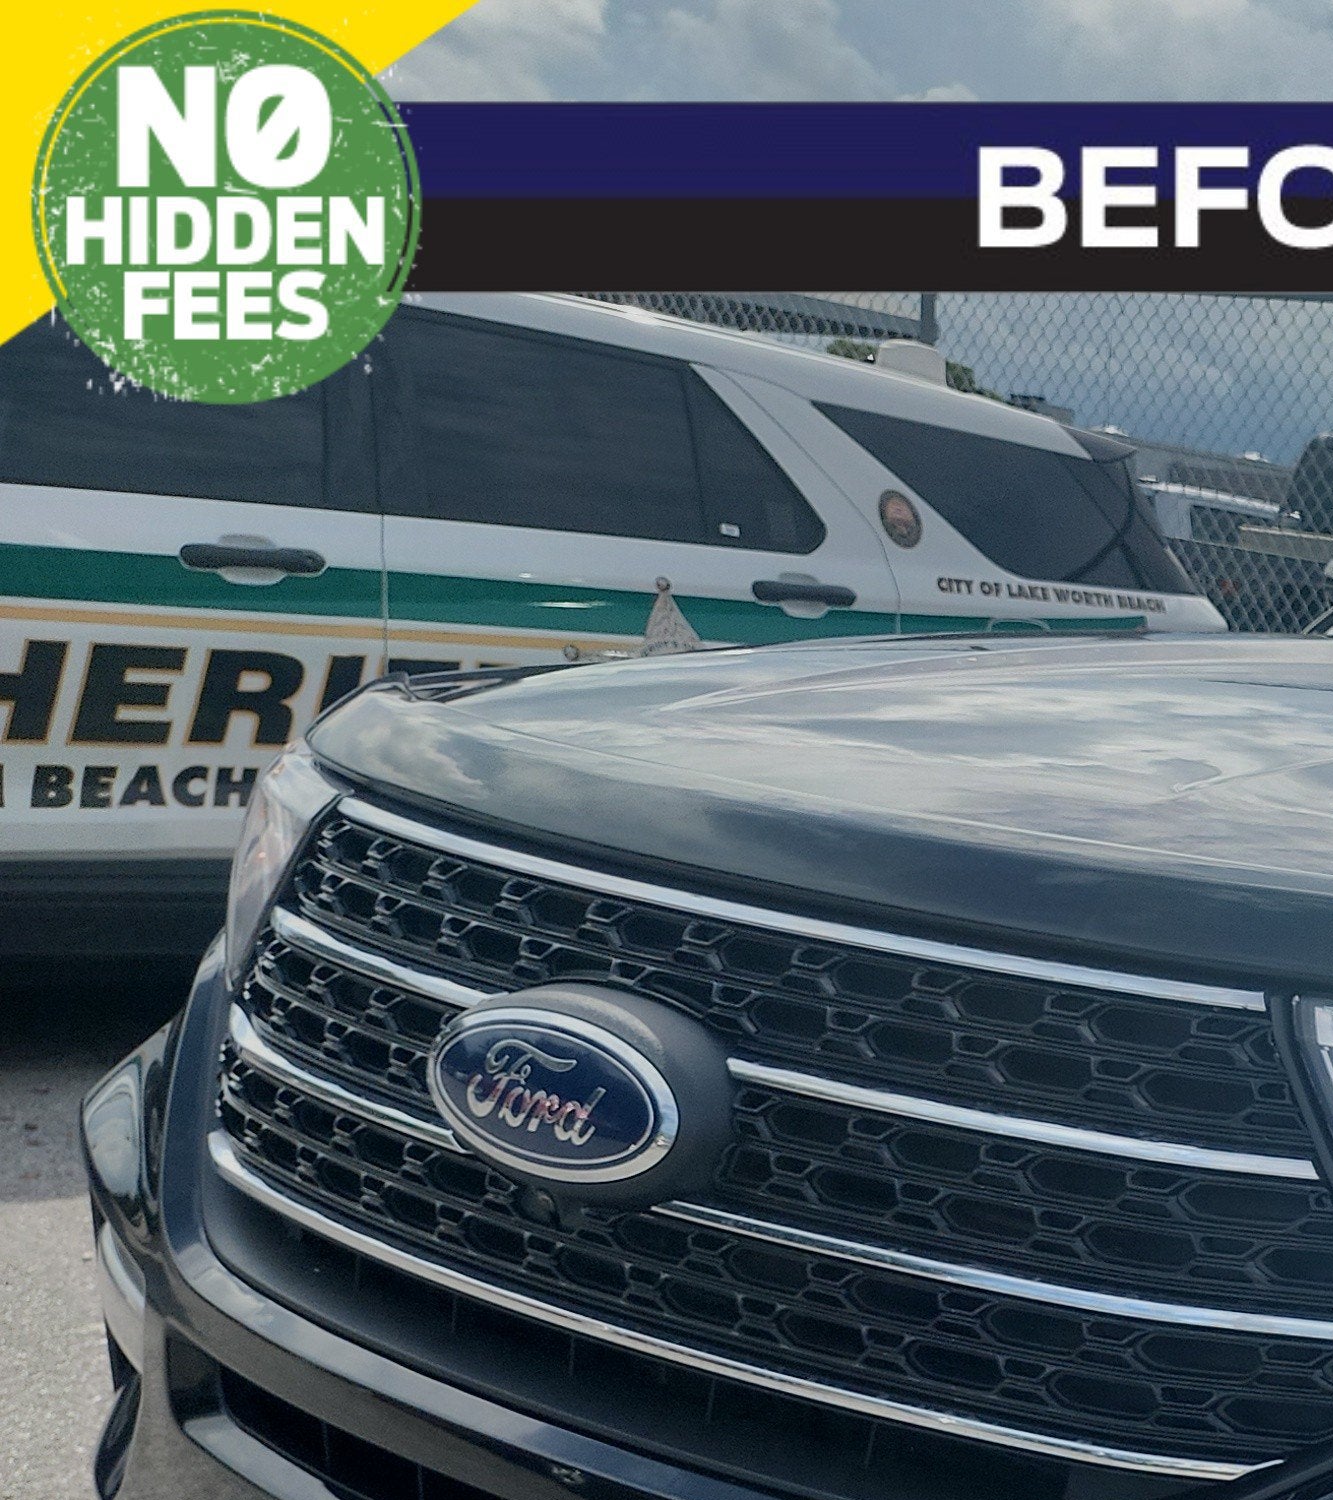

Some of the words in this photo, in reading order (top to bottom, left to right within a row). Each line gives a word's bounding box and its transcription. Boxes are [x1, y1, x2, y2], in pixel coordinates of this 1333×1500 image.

[937, 577, 973, 594] CITY
[979, 581, 1003, 597] OF
[1007, 583, 1050, 601] LAKE
[30, 763, 259, 809] BEACH
[466, 1038, 606, 1146] Ford
